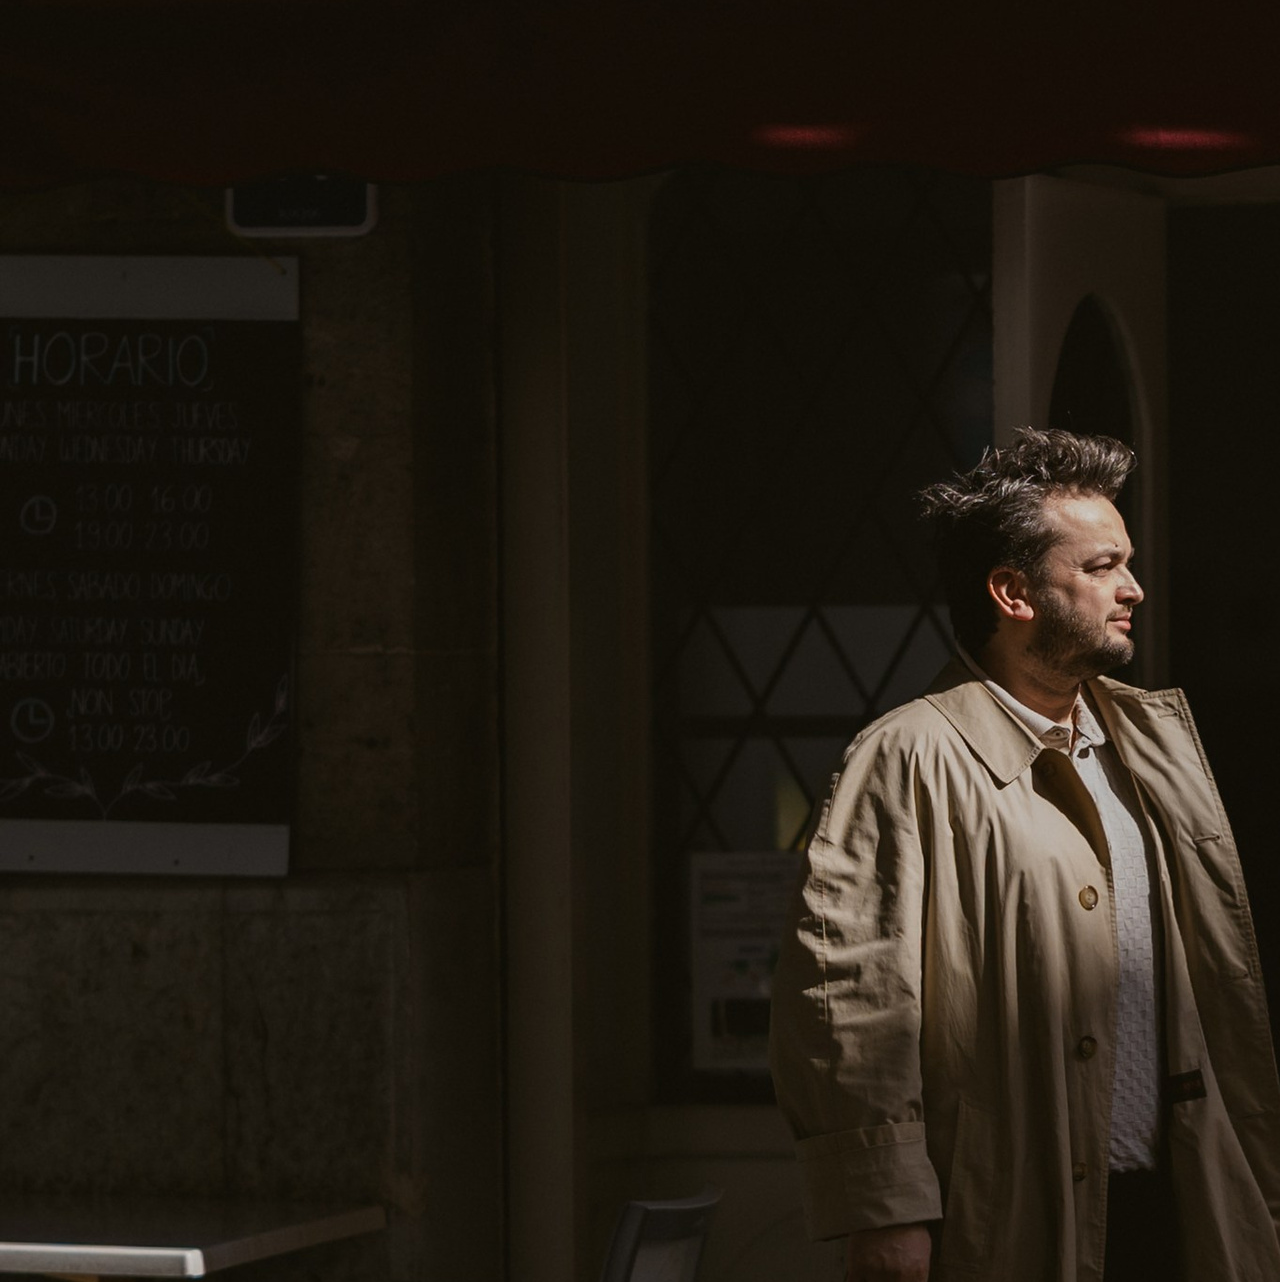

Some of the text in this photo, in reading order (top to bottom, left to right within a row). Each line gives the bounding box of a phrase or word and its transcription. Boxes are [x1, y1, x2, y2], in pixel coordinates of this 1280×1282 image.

[12, 331, 210, 387] HORARIO
[170, 401, 238, 430] JUEVES
[150, 572, 232, 602] DOMINGO
[83, 652, 131, 681] TODO
[143, 652, 160, 681] EL
[65, 687, 114, 719] NON
